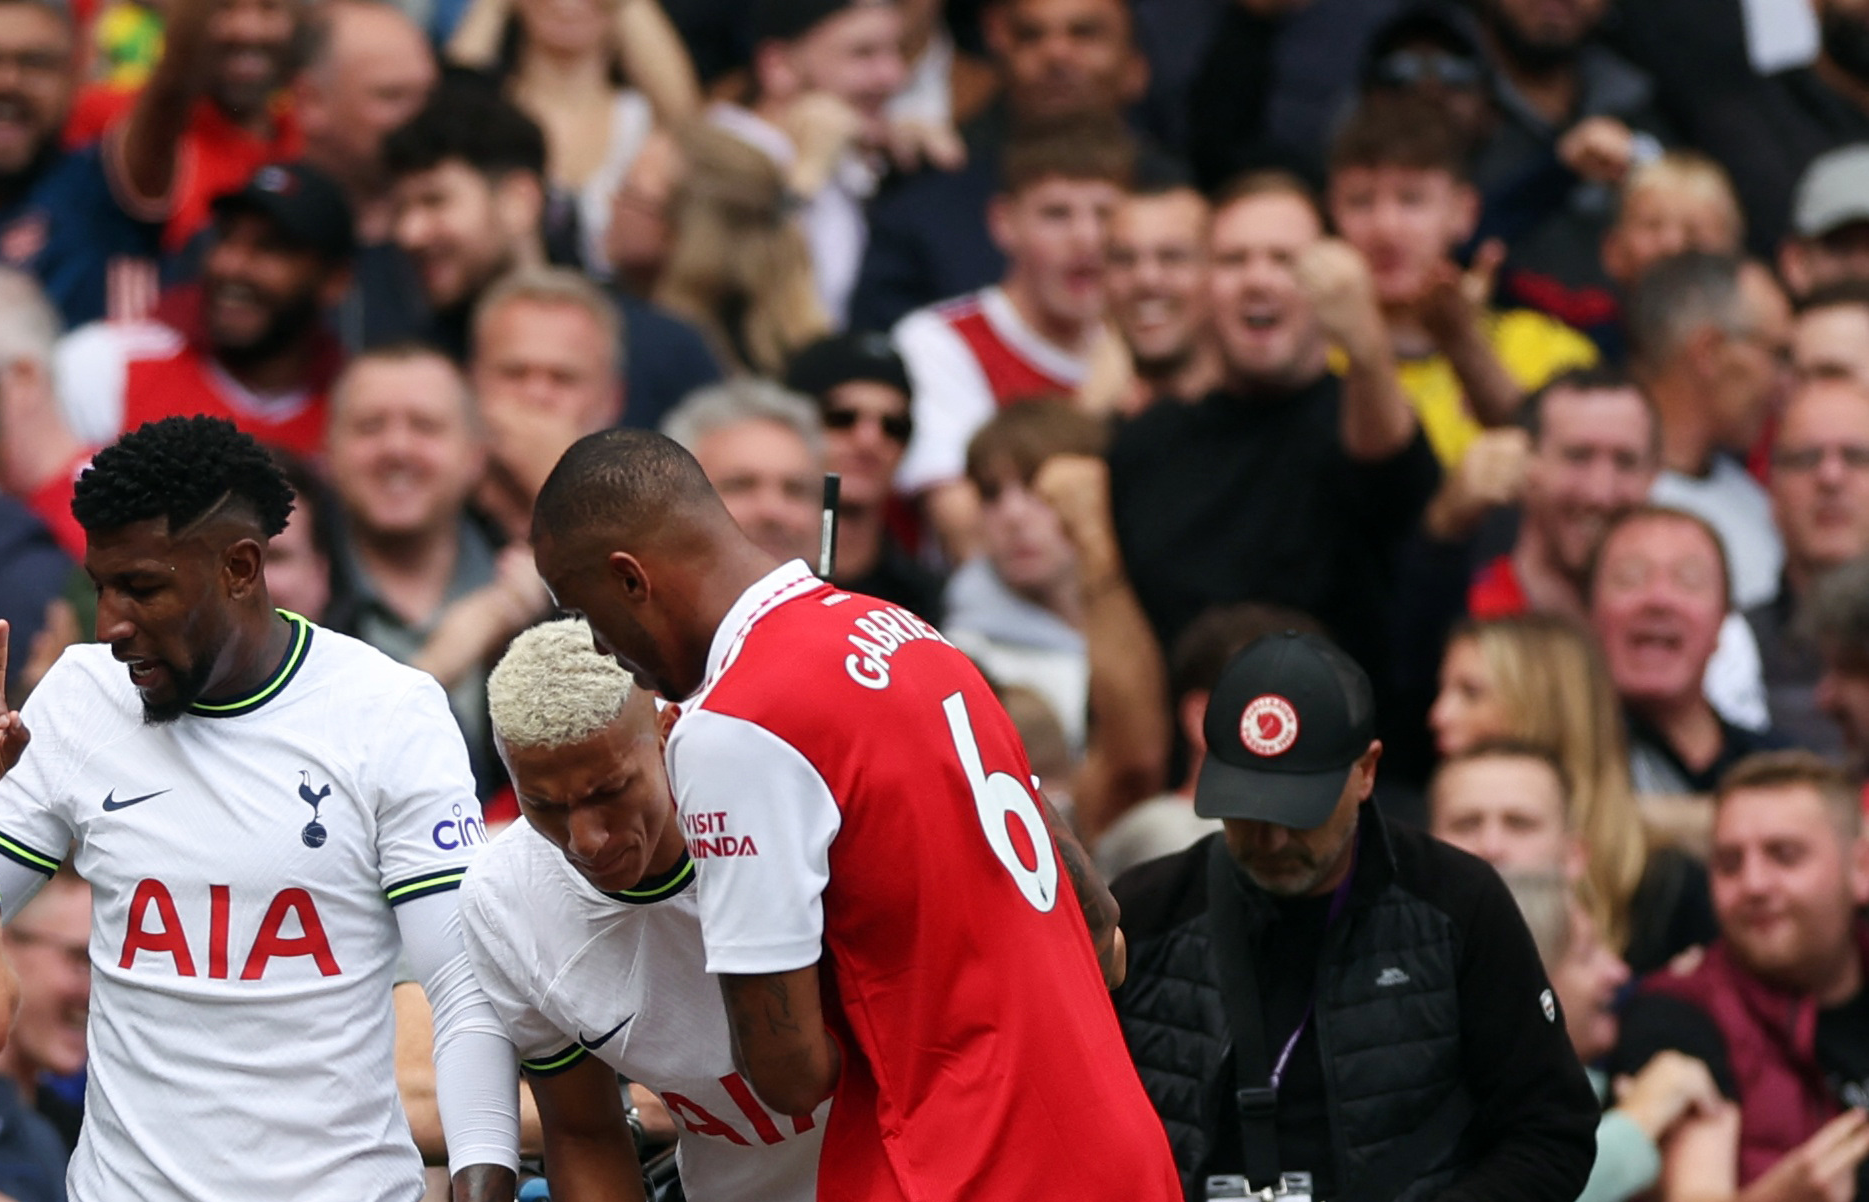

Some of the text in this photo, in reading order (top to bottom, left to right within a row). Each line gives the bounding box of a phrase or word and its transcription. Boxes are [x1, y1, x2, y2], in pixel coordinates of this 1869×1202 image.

[845, 607, 956, 690] GABRIE
[681, 811, 728, 835] VISIT
[942, 690, 1059, 913] 6
[118, 878, 343, 981] AIA
[660, 1072, 818, 1147] AI
